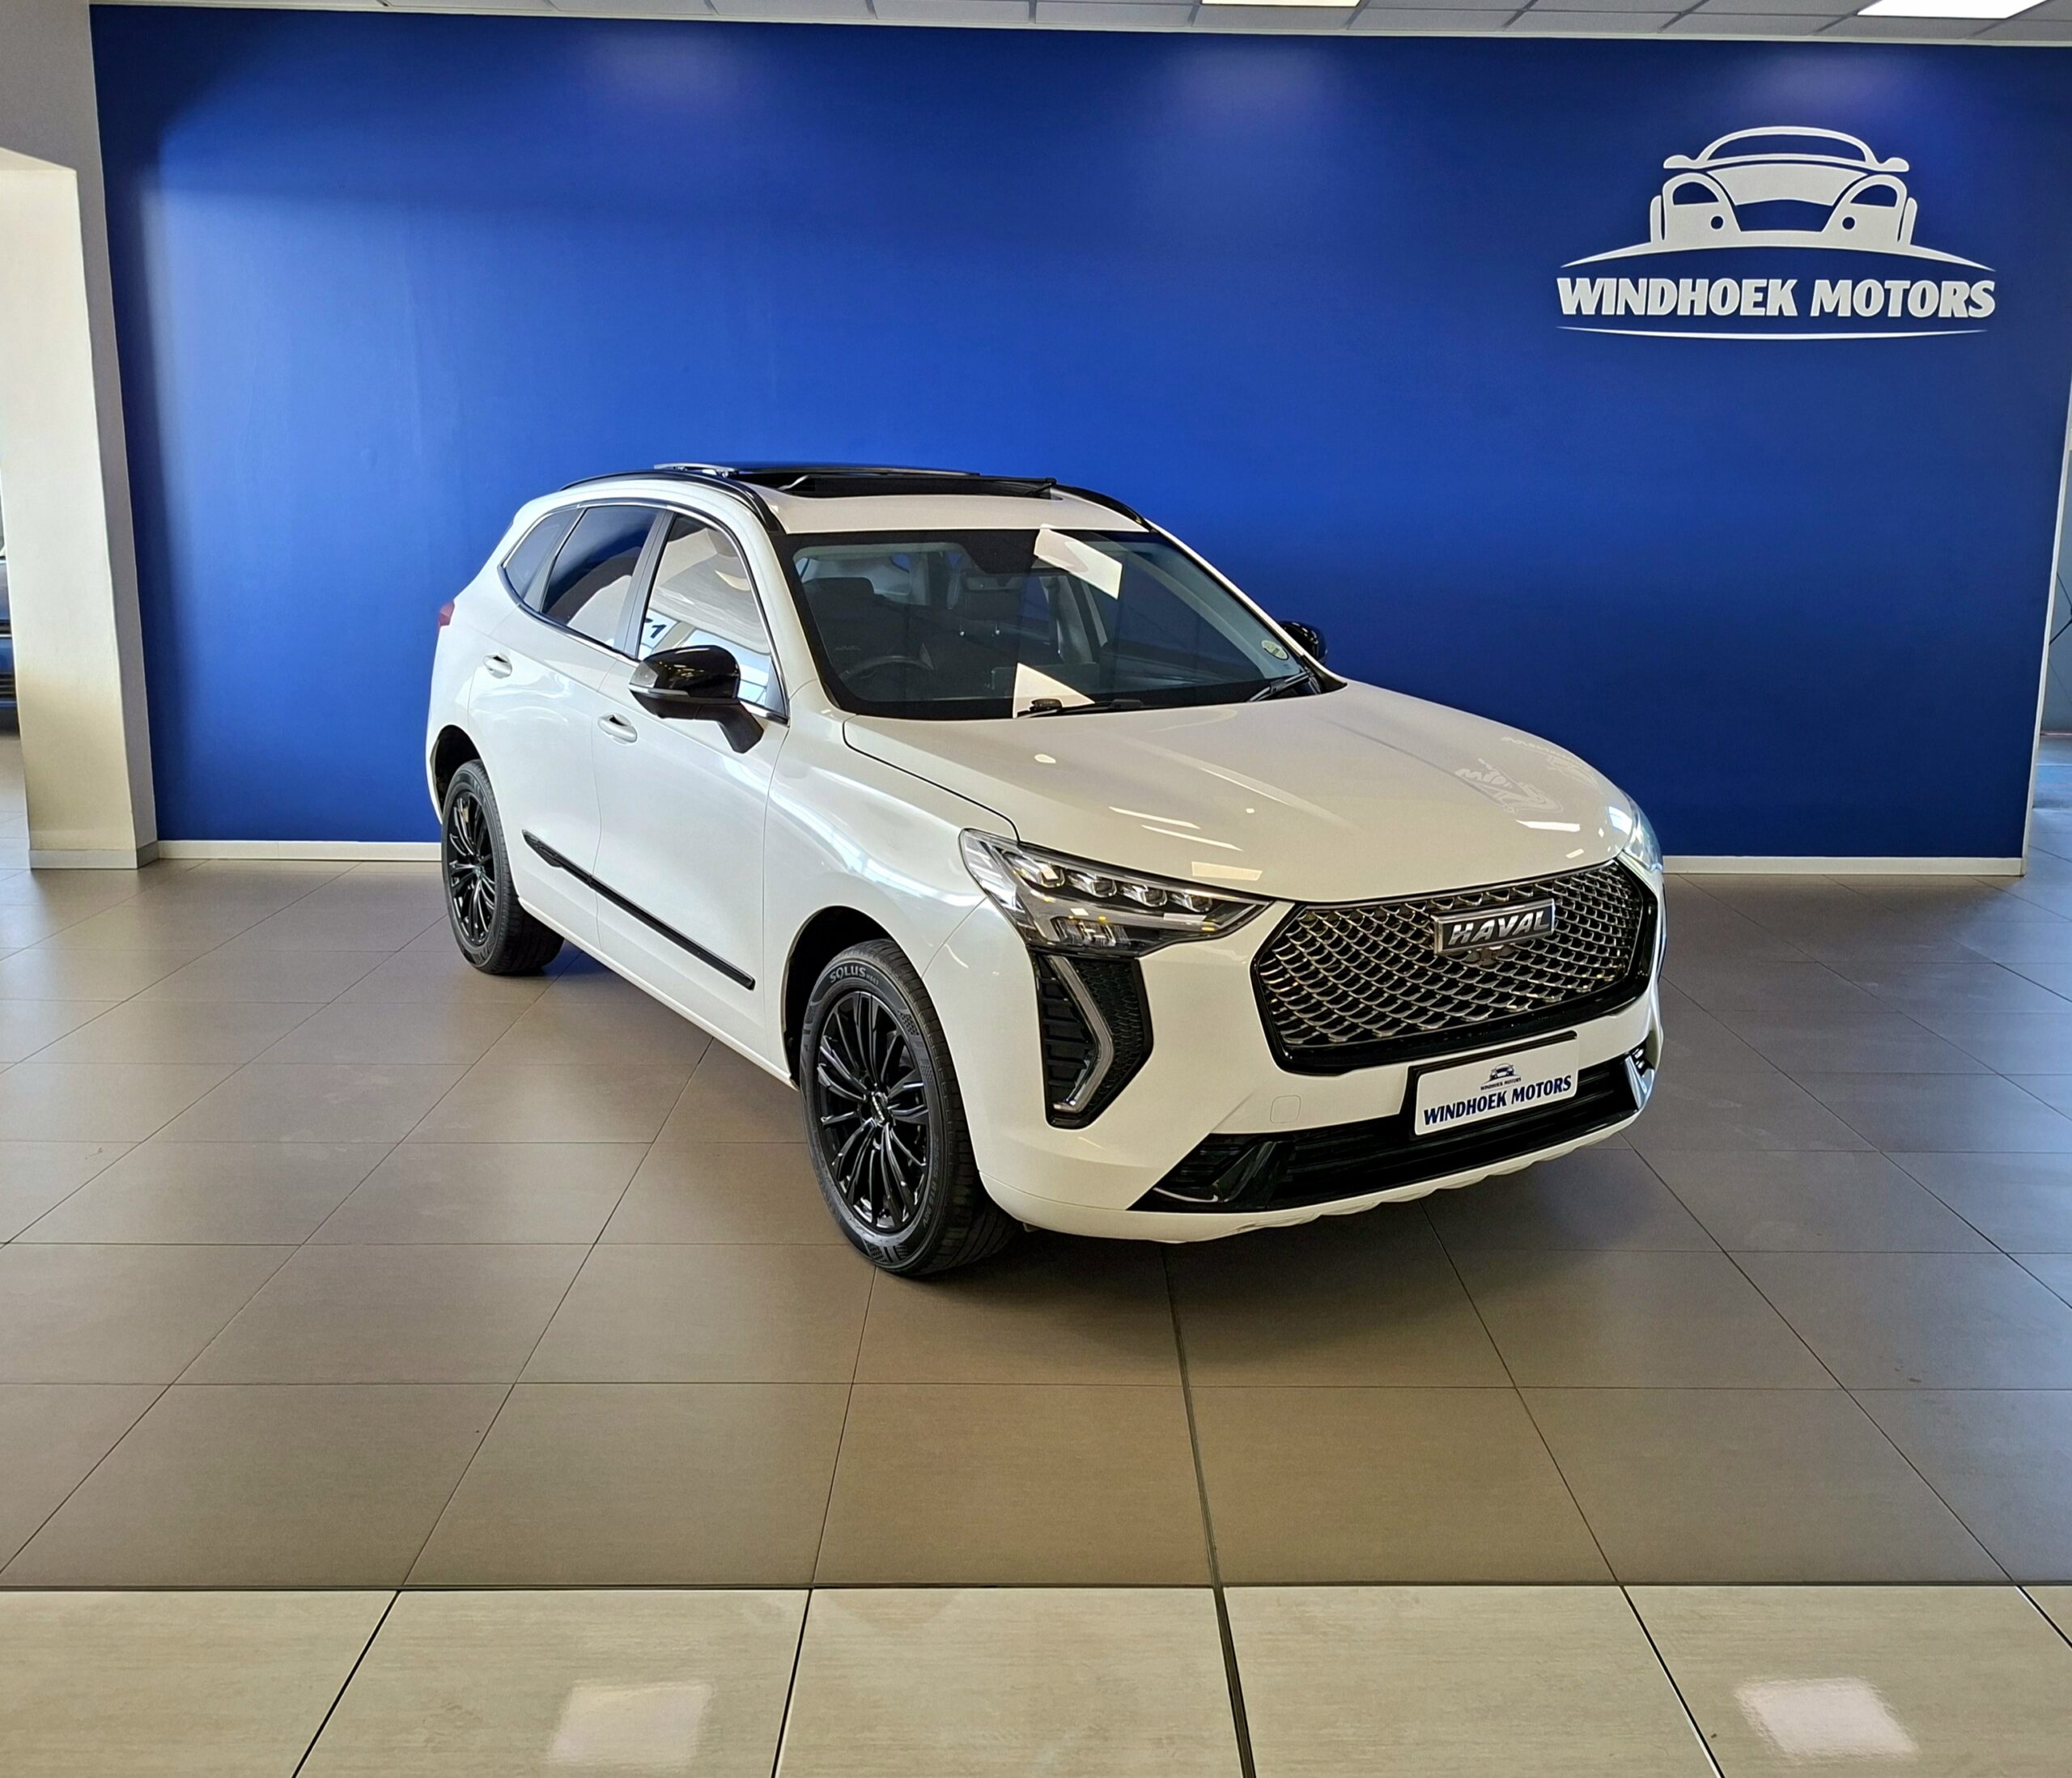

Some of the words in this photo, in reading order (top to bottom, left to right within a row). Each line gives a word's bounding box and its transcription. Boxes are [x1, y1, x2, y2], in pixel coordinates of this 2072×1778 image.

[1556, 278, 1798, 316] WINDHOEK
[1810, 279, 1996, 318] MOTORS
[1448, 910, 1550, 945] HAVAL
[830, 965, 866, 983] SOLUS
[1424, 1091, 1507, 1125] WINDHOEK
[1511, 1075, 1572, 1105] MOTORS
